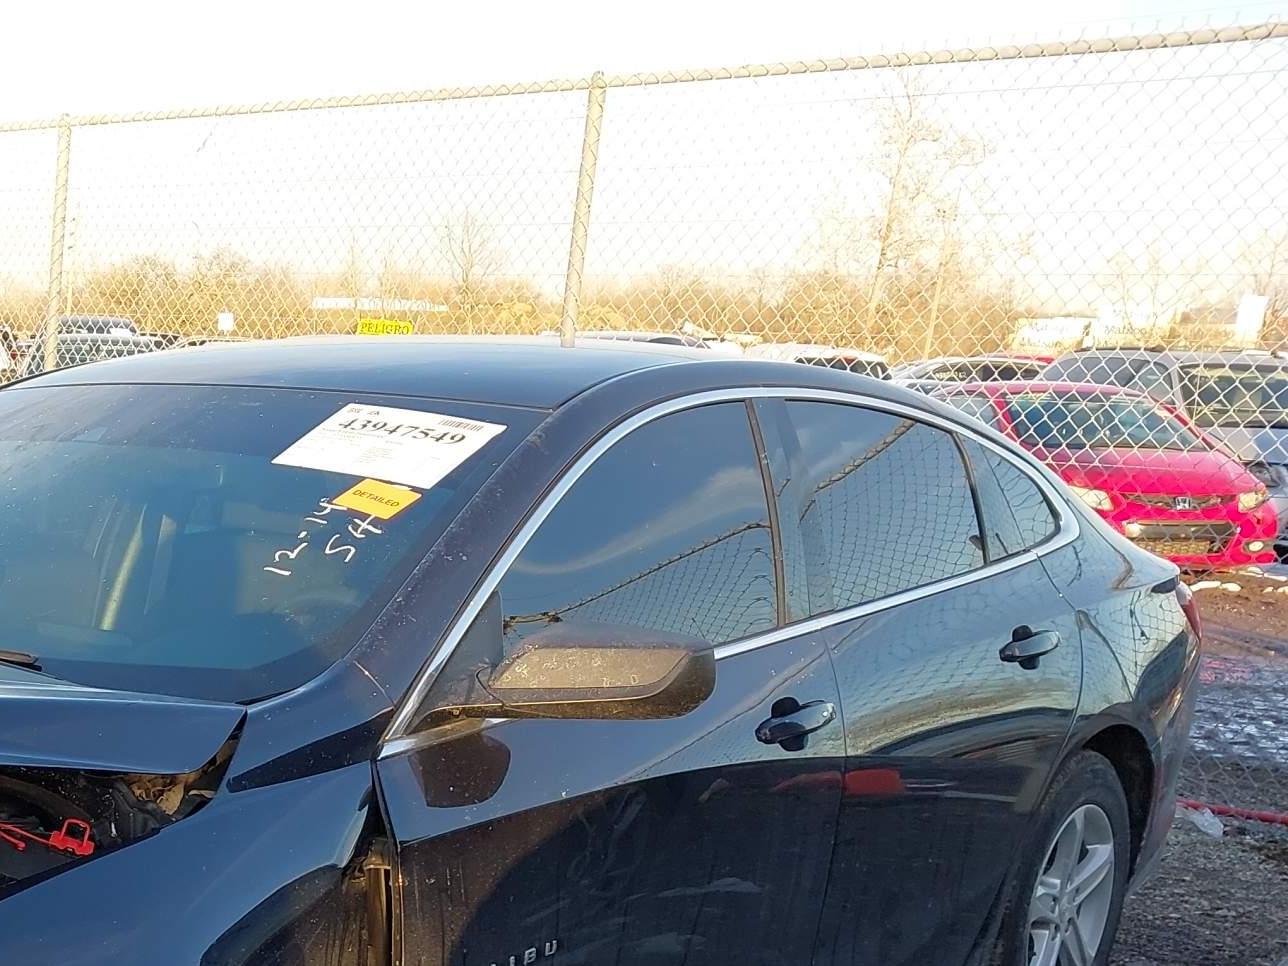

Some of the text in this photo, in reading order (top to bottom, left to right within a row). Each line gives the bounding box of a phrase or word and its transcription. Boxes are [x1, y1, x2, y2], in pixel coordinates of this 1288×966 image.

[360, 321, 410, 335] PELIGRO
[338, 418, 466, 444] 43947549
[351, 489, 400, 508] DETAILED
